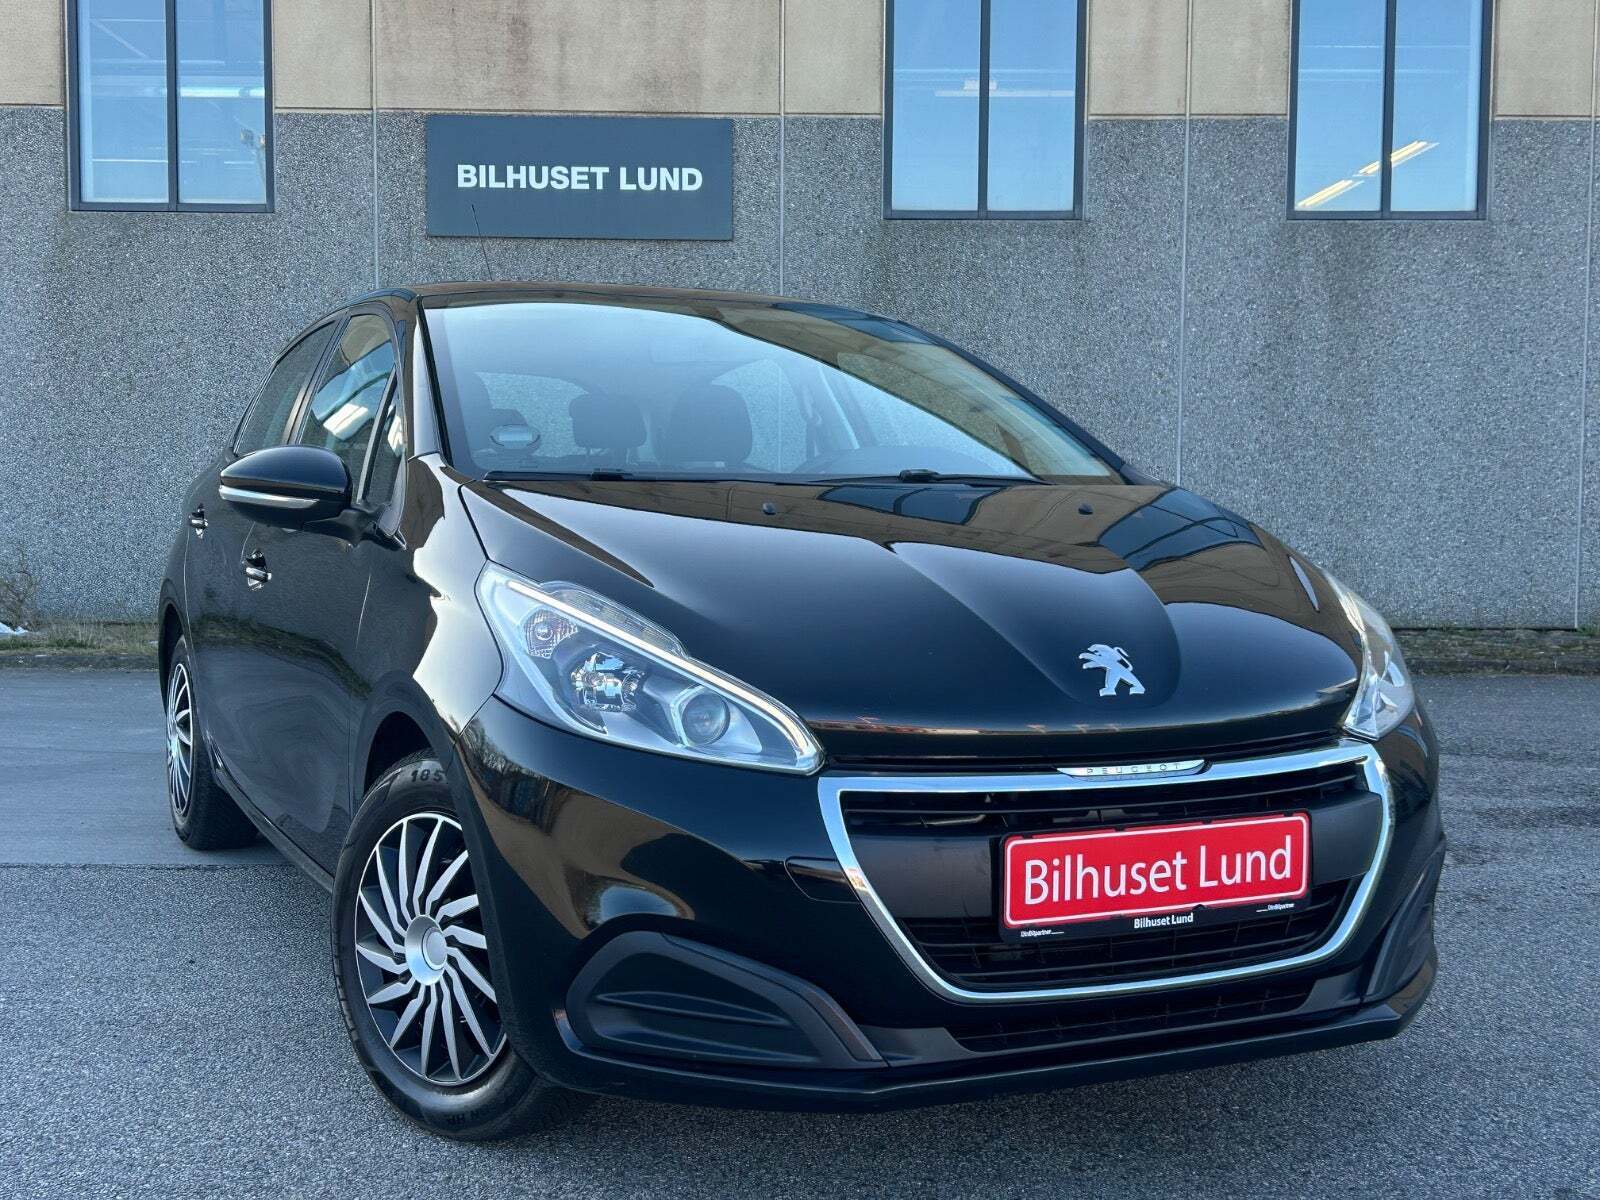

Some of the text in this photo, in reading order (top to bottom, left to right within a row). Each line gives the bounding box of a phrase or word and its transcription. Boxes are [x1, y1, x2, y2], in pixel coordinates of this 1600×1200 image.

[457, 164, 703, 191] BILHUSET LUND
[411, 768, 444, 782] 185
[1086, 763, 1181, 775] PEUGEOT
[1024, 835, 1291, 905] Bilhuset Lund
[1134, 912, 1193, 929] Bilhuset Lund
